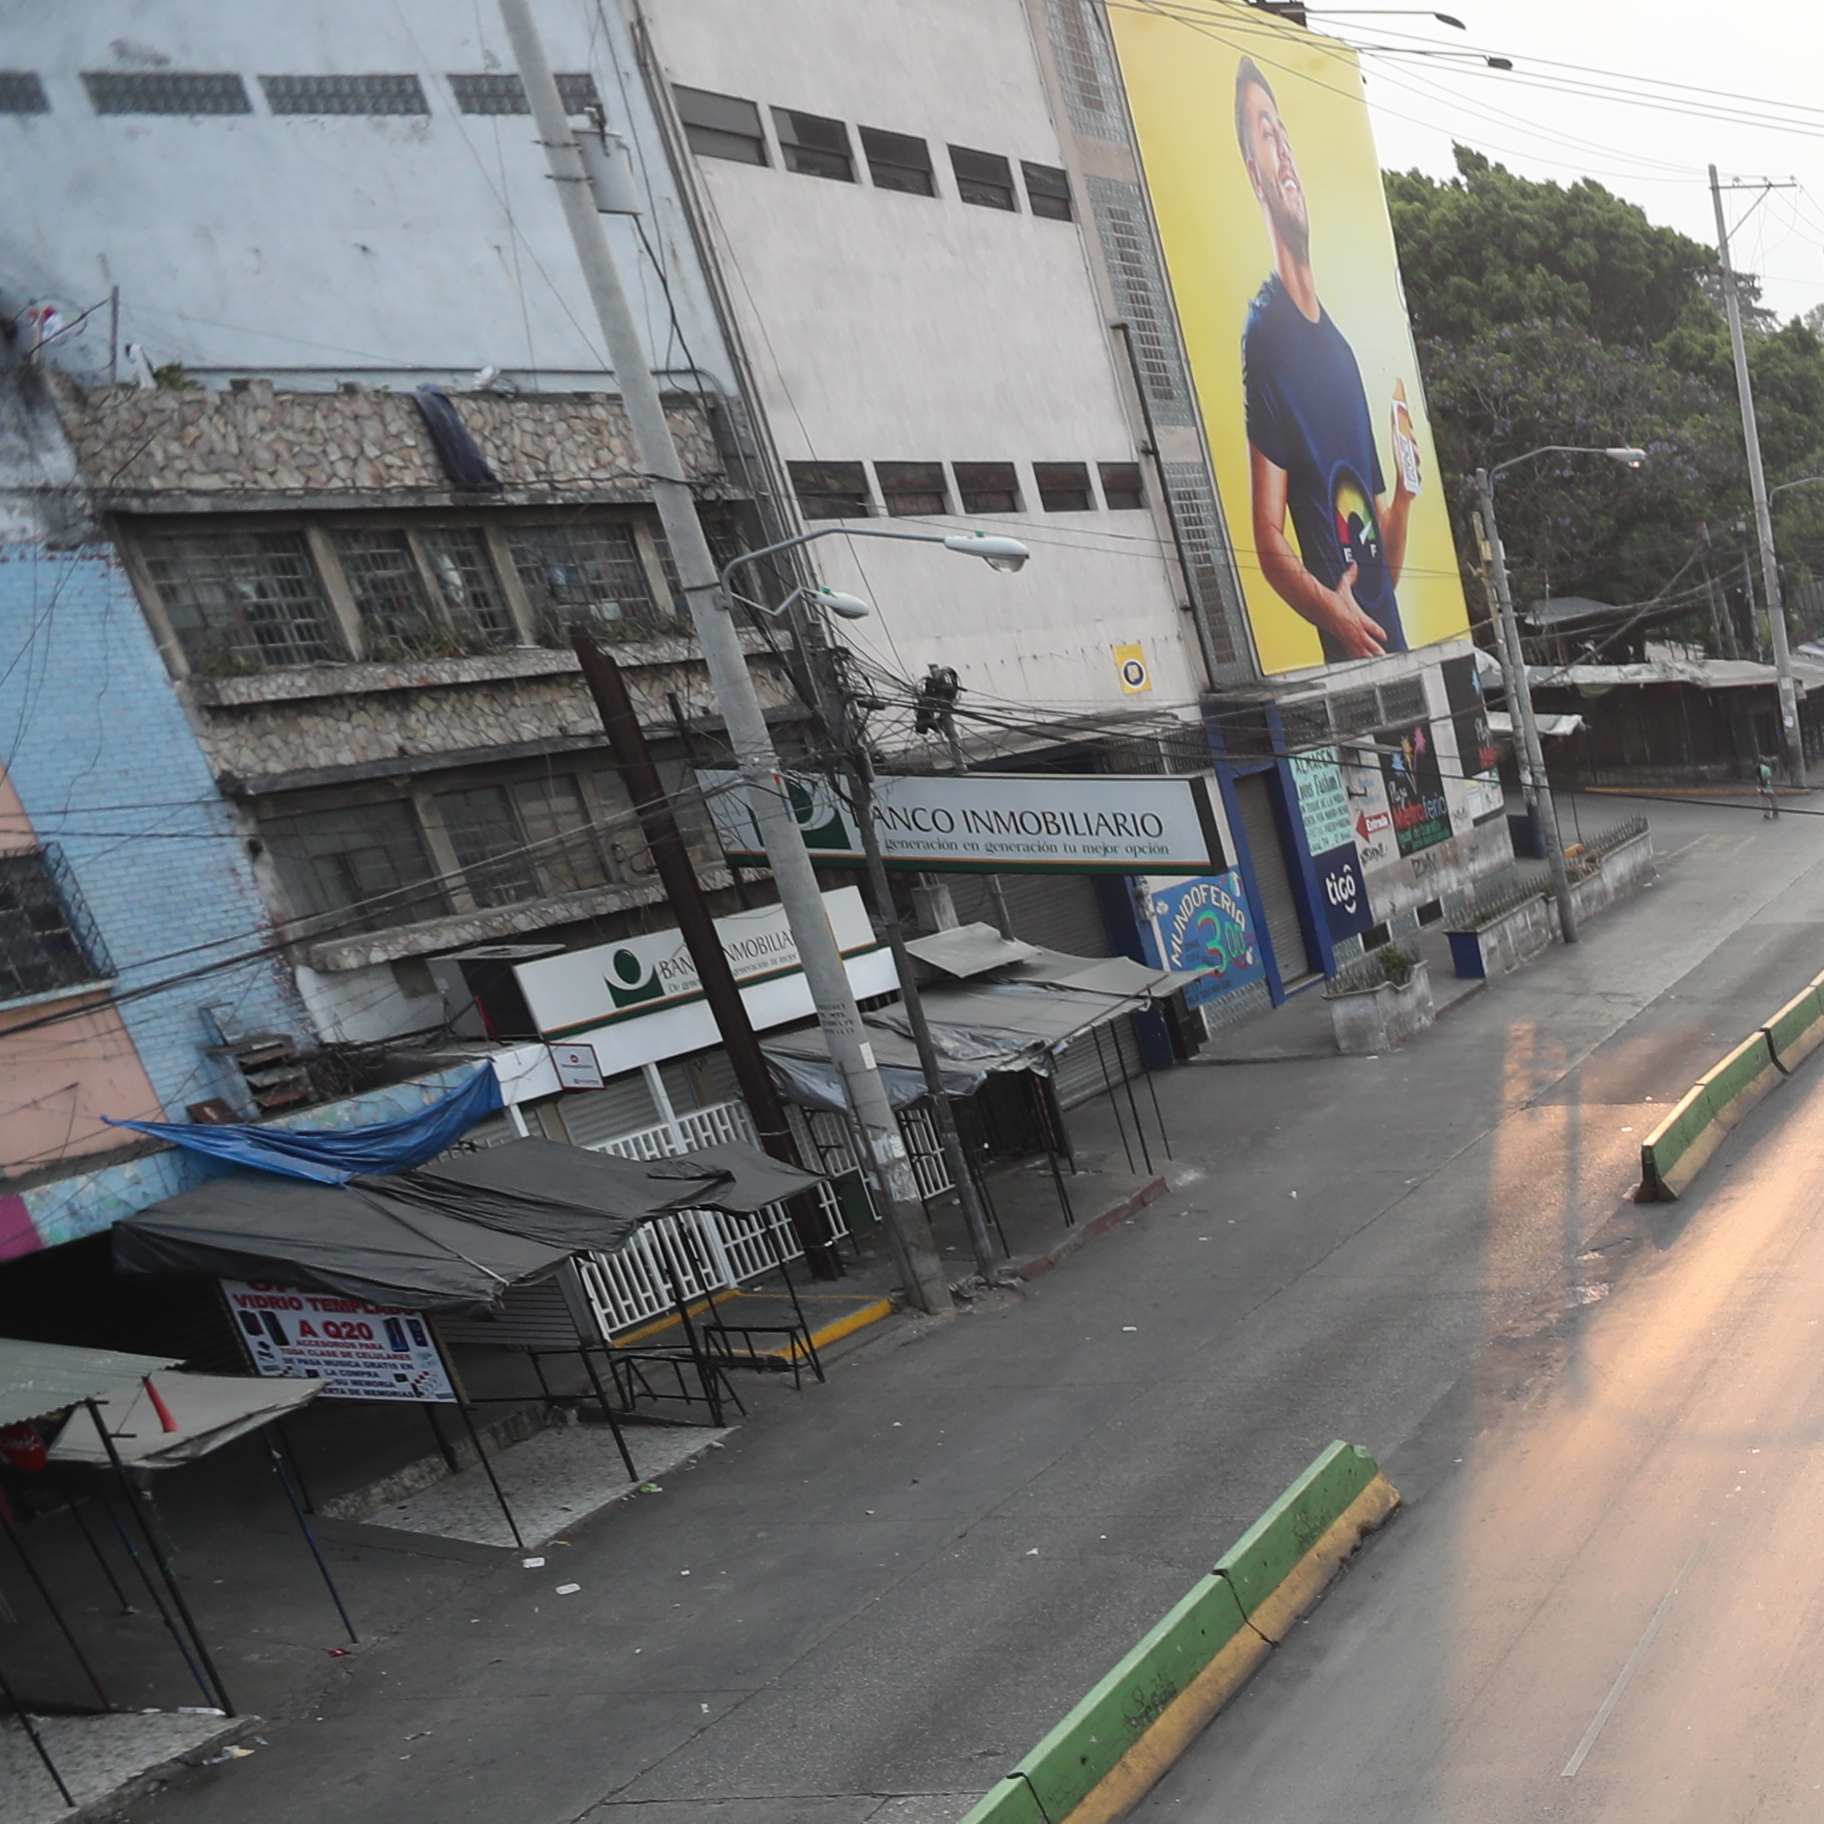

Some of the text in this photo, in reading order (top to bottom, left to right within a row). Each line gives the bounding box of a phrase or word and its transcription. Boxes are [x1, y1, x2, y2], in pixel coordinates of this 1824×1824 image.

[1370, 544, 1377, 558] F
[961, 808, 1163, 838] INMOBILIARIO
[885, 836, 959, 850] generación
[963, 842, 980, 851] en
[985, 839, 1058, 853] generación
[1125, 842, 1169, 858] opción
[1170, 883, 1246, 968] MUNDOFERIA
[659, 955, 696, 980] BAN
[232, 1294, 304, 1311] VIDRIO
[300, 1319, 374, 1341] A Q20
